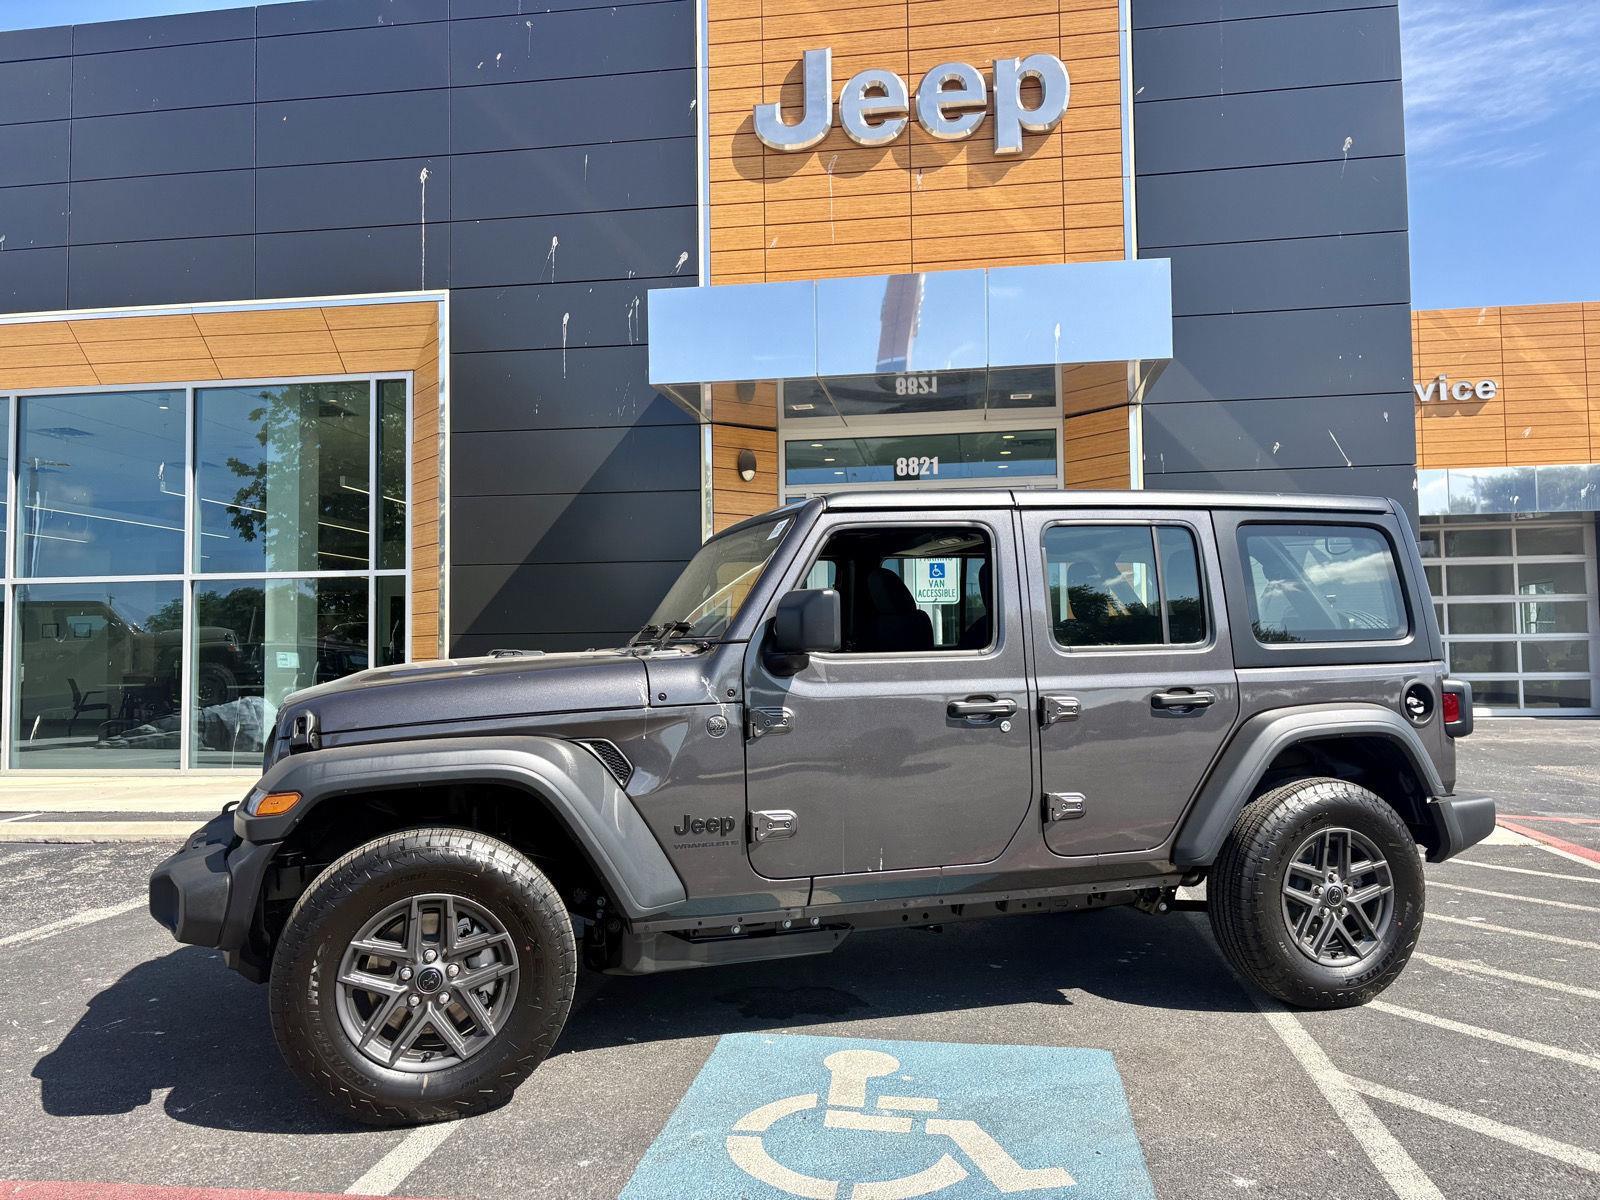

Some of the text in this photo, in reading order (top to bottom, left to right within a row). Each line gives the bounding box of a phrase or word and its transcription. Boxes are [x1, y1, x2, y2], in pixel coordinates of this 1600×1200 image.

[752, 47, 1071, 155] Jeep
[1413, 373, 1497, 402] vice
[896, 456, 939, 477] 8821
[917, 588, 956, 598] ACCESSIBLE
[928, 579, 945, 588] VAN
[674, 814, 735, 837] Jeep
